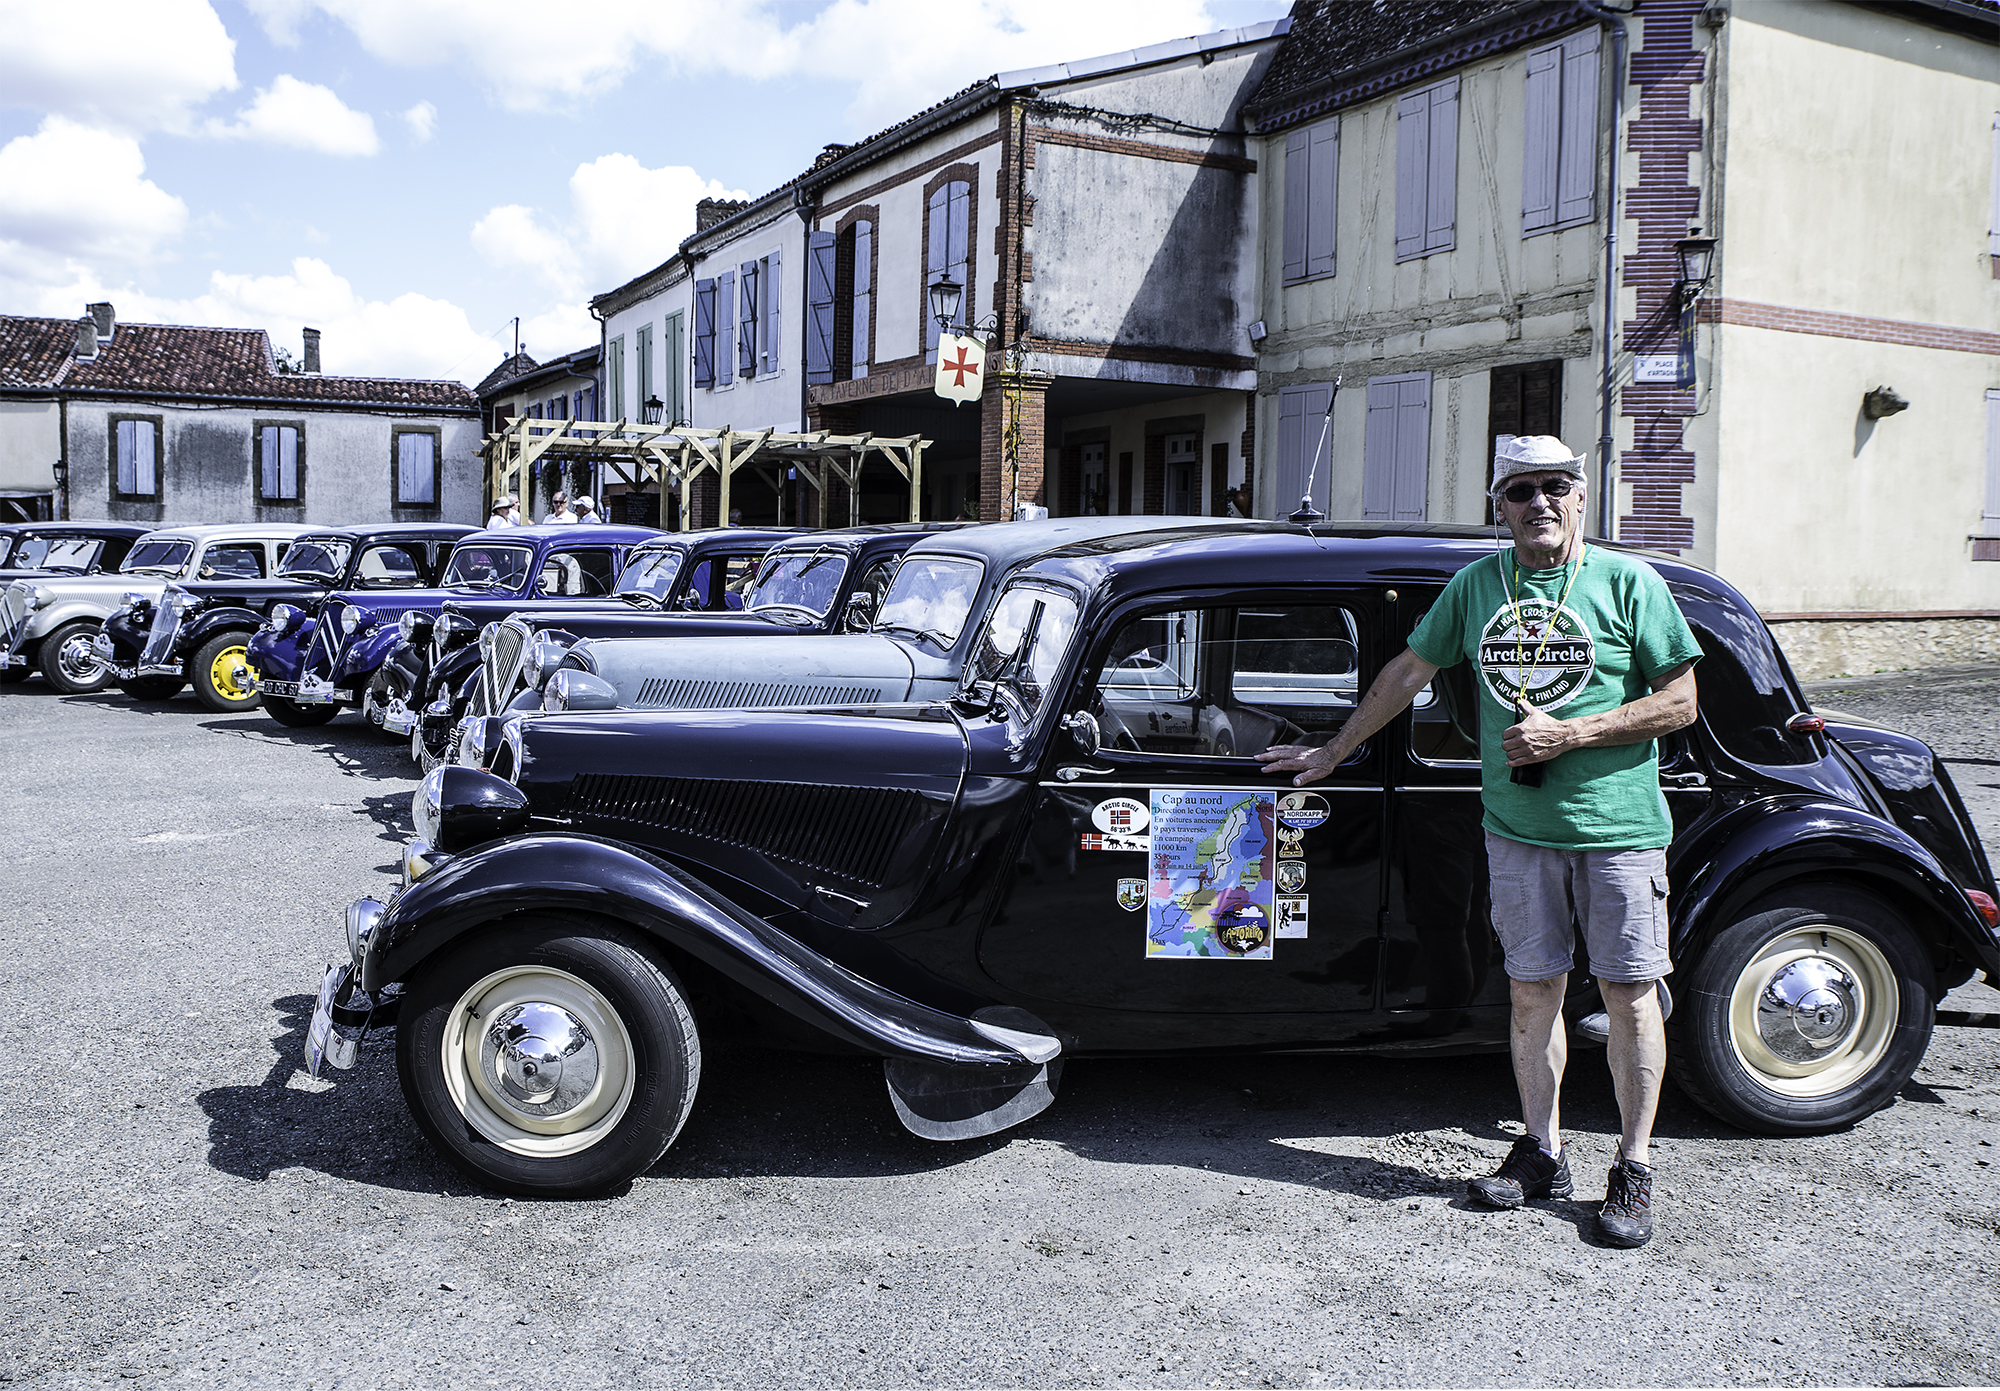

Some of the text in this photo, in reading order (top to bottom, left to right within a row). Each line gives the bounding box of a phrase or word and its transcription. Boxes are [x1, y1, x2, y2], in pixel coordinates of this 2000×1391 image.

[1655, 360, 1674, 368] PLACE
[830, 377, 876, 400] TAVERNE
[1556, 616, 1571, 630] THE
[1483, 646, 1585, 662] Arctic Circle
[1535, 680, 1570, 702] FINLAND
[1162, 794, 1223, 806] Cap au nord
[1256, 795, 1269, 804] Cap
[1101, 802, 1139, 813] ARCTIC CIRCLE
[1154, 806, 1186, 814] Direction
[1195, 808, 1209, 816] Cap
[1211, 807, 1228, 815] Nord
[1256, 804, 1273, 812] Nord
[1165, 815, 1192, 824] voitures
[1160, 826, 1176, 834] pays
[1154, 834, 1164, 842] En
[1165, 835, 1194, 844] camping
[1152, 937, 1165, 946] Dax
[623, 1070, 658, 1147] MICHELIN
